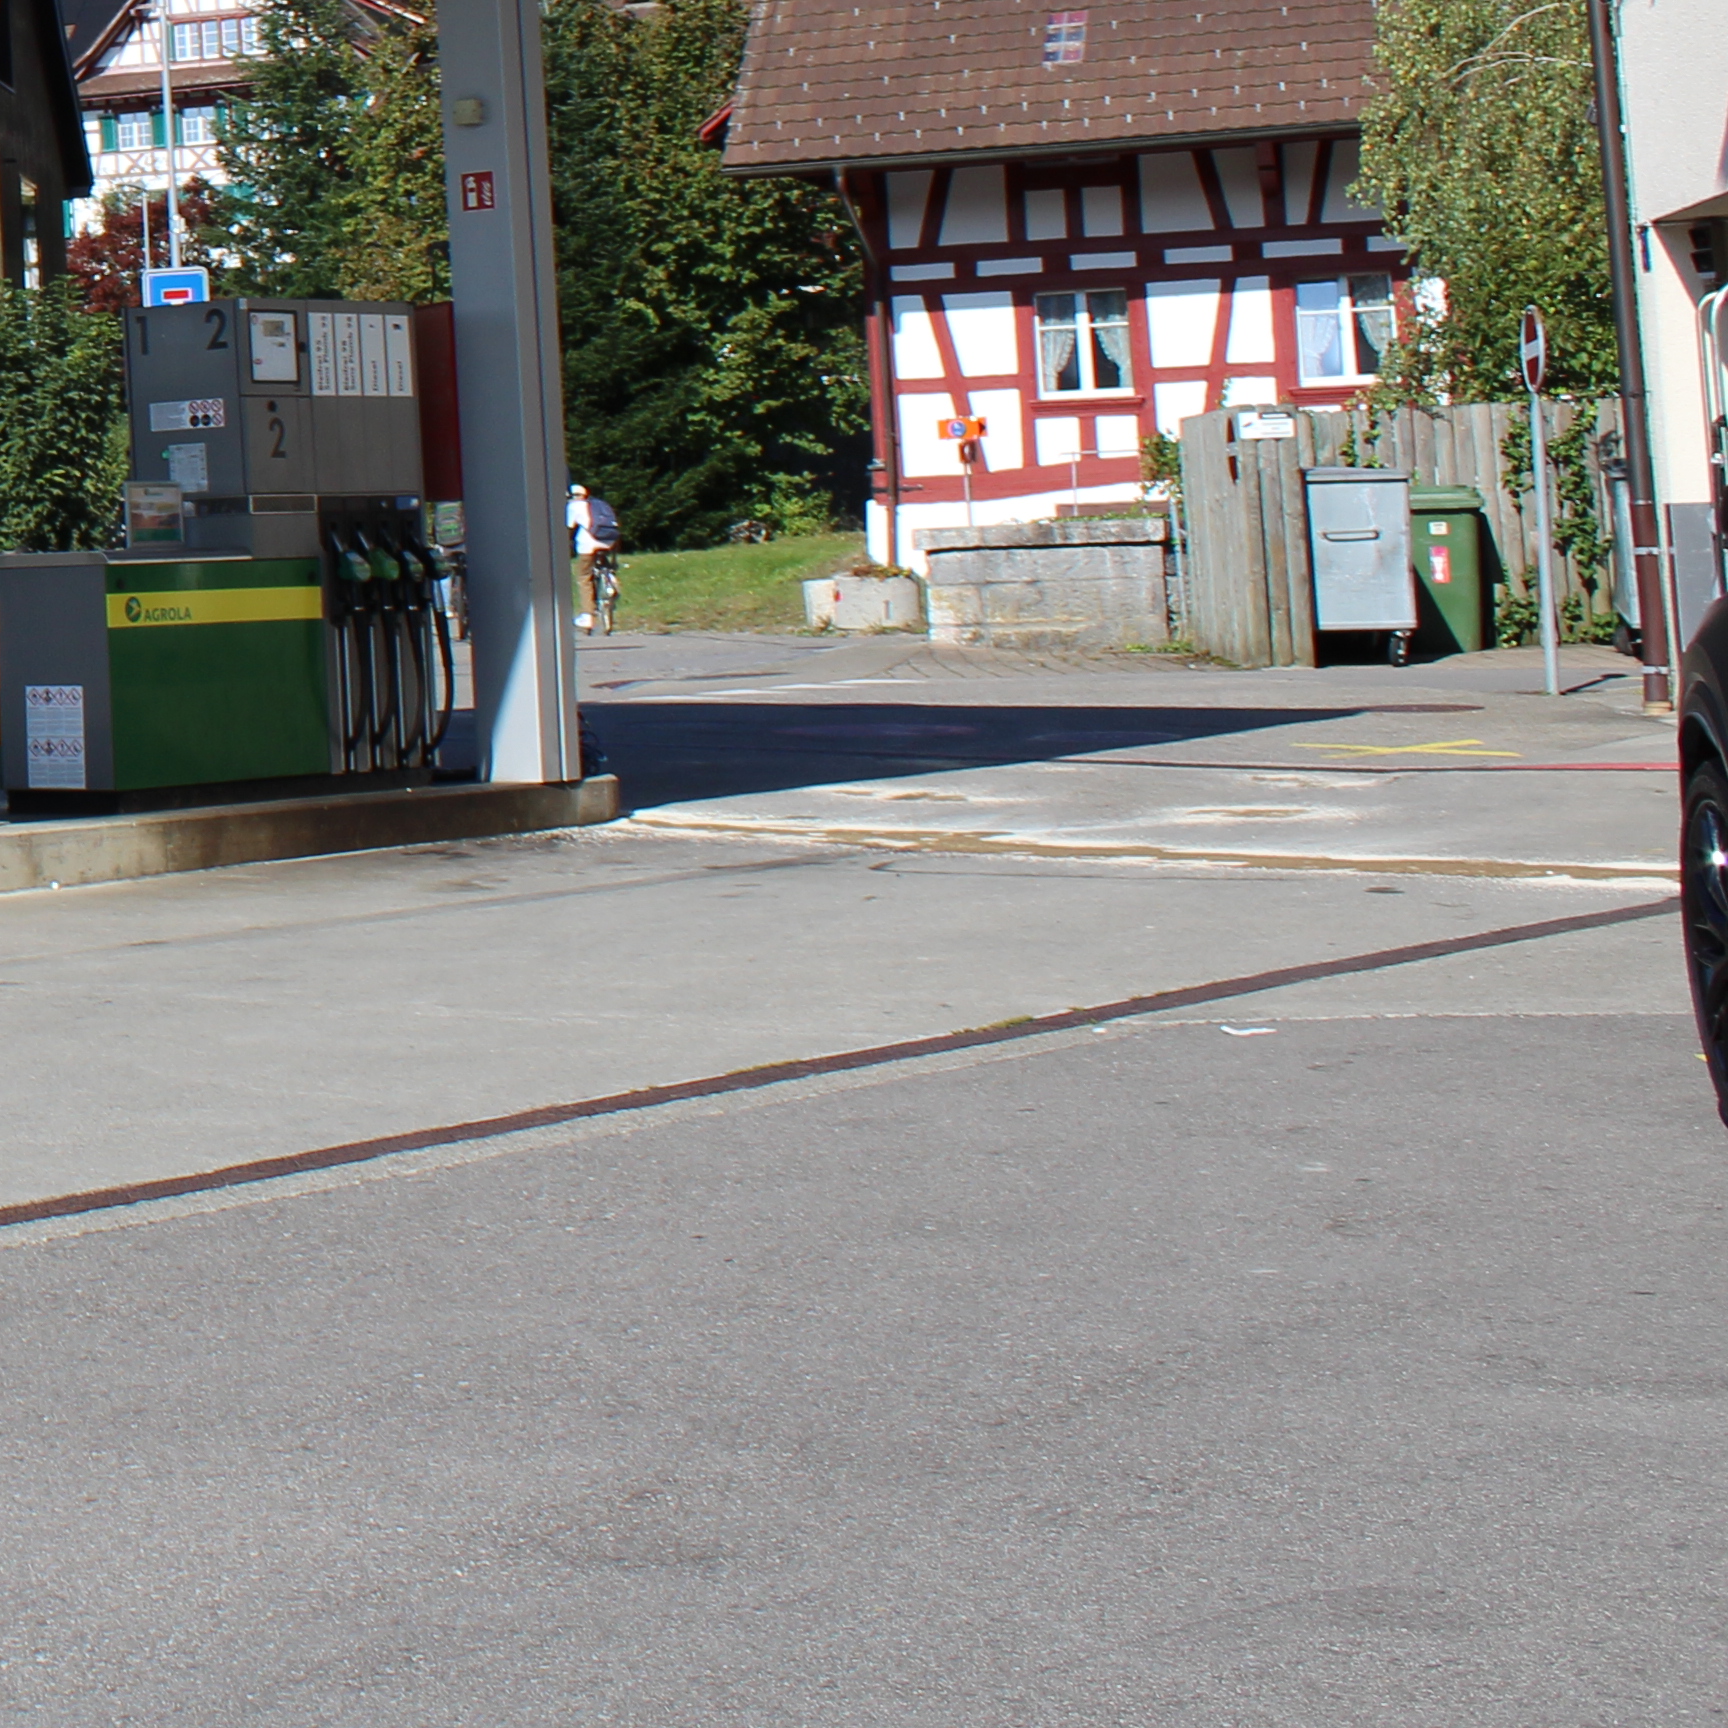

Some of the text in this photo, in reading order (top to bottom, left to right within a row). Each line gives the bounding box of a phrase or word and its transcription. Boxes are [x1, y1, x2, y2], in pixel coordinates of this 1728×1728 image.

[135, 308, 228, 355] 1 2
[269, 416, 287, 459] 2
[144, 606, 193, 622] AGROLA
